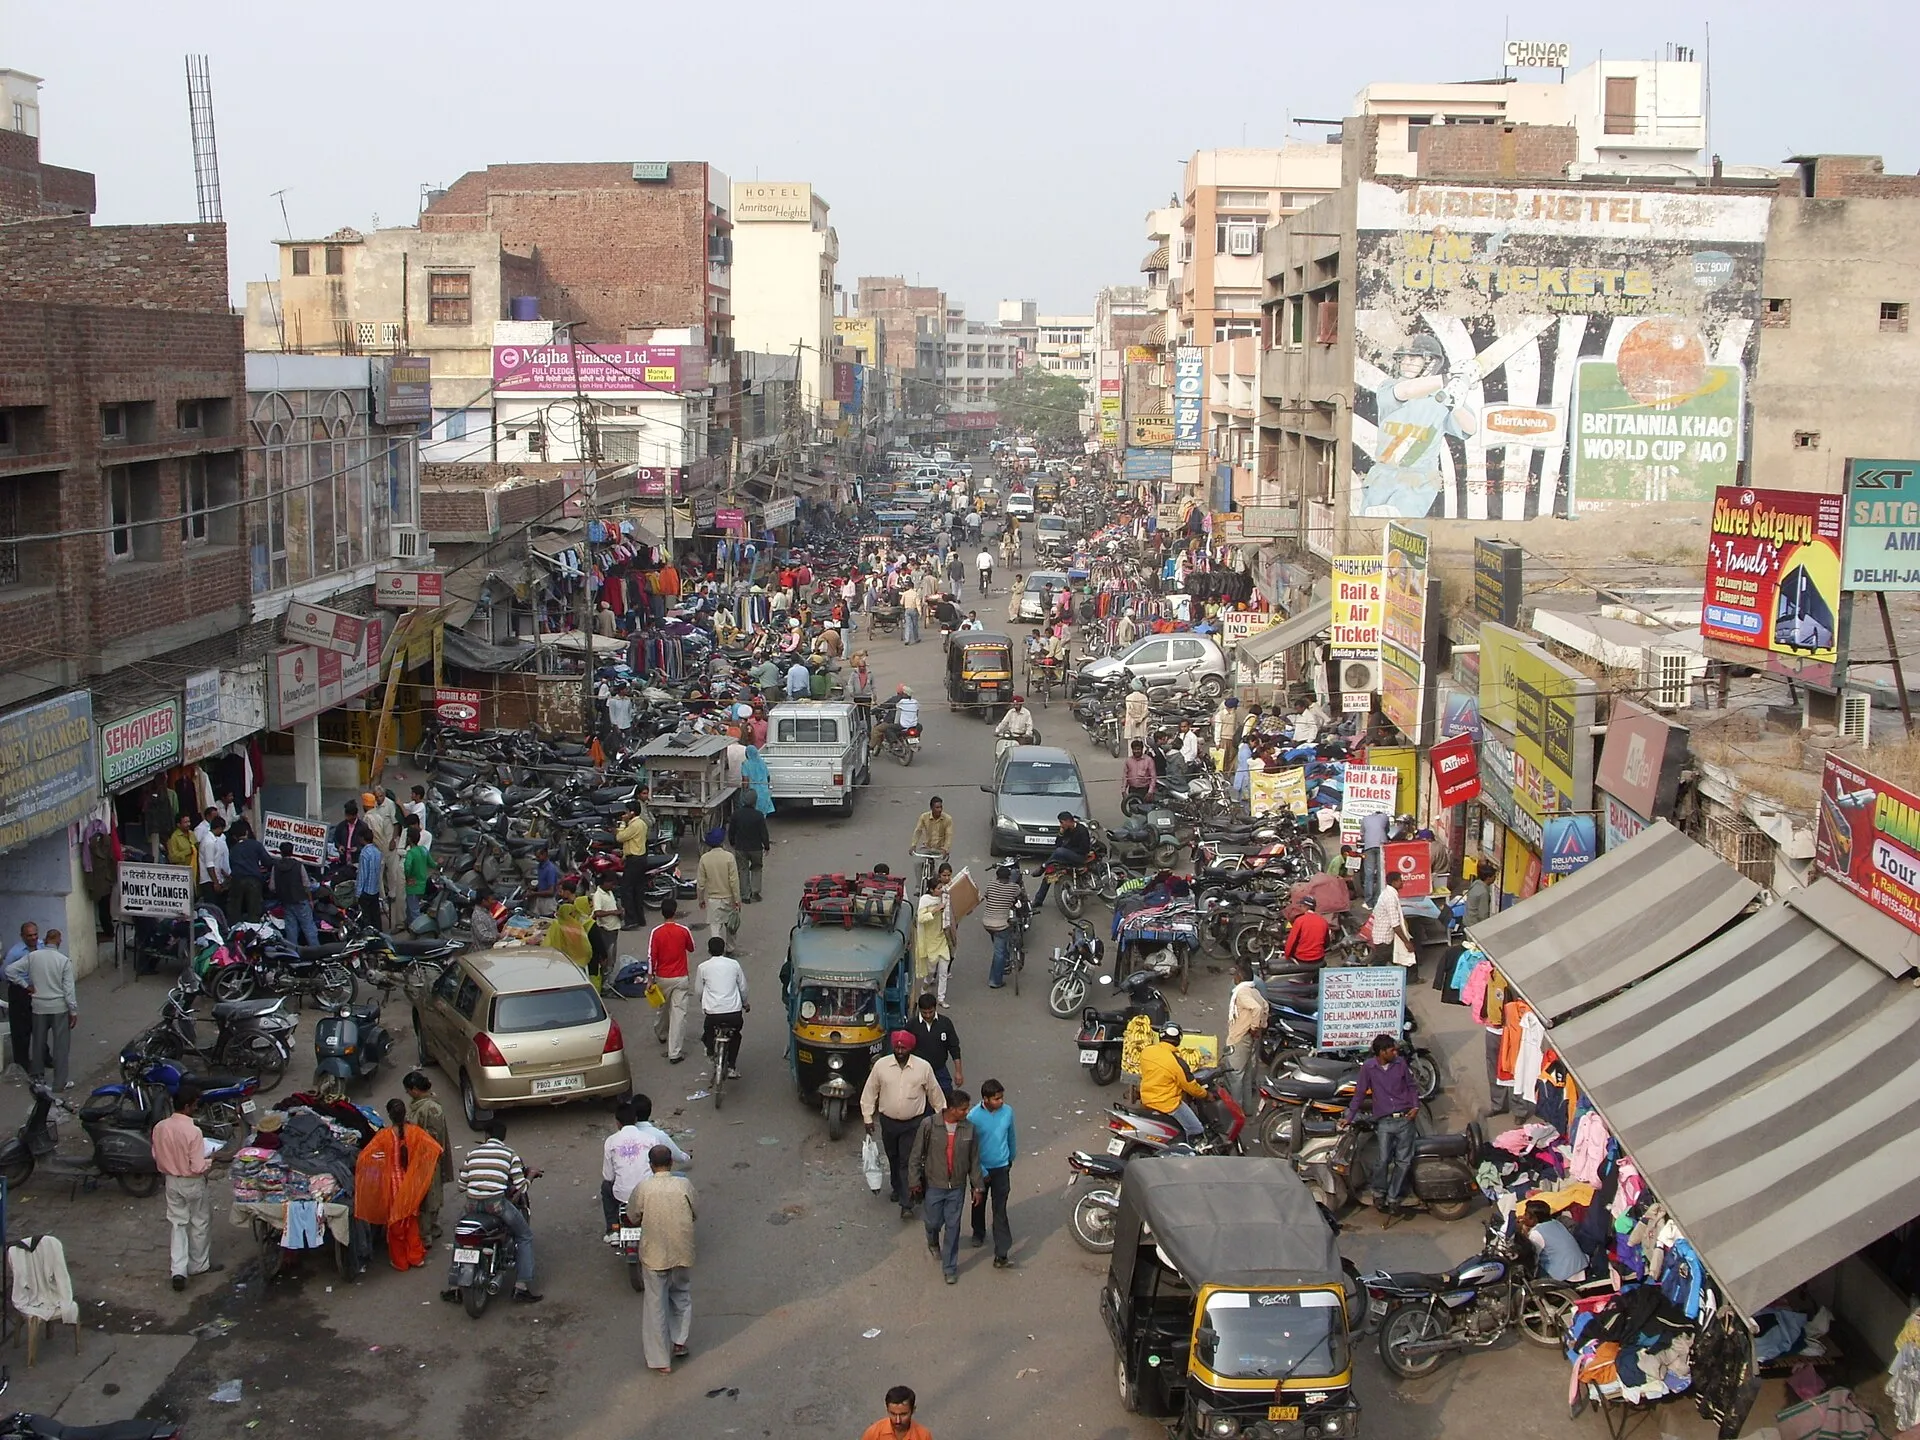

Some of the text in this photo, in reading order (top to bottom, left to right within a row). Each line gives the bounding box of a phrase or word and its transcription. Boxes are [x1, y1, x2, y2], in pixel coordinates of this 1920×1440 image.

[1507, 42, 1568, 58] CHINAR
[1516, 56, 1563, 67] HOTEL
[746, 188, 799, 197] HOTEL
[738, 202, 778, 212] Amritsar
[775, 205, 807, 219] Heights
[1533, 194, 1651, 223] HOTEL
[1687, 261, 1731, 273] ERYBODY
[522, 348, 568, 367] Majha
[575, 350, 622, 364] Finance
[624, 350, 650, 364] Ltd.
[531, 367, 548, 375] FULL
[549, 367, 579, 375] FLEDGE
[580, 367, 605, 375] MONEY
[1176, 362, 1203, 439] HOTEL
[1138, 418, 1173, 426] HOTEL
[1493, 414, 1548, 428] BRITANNIA
[1582, 413, 1733, 437] BRITANNIA KHAO
[1584, 439, 1648, 461] WORLD
[1651, 440, 1686, 461] CUP
[637, 469, 654, 480] TD.
[1713, 497, 1750, 536] Shree
[1752, 501, 1813, 549] Satguru
[1885, 532, 1920, 550] AM
[1725, 541, 1769, 577] Travels
[1333, 559, 1383, 576] SHUBH KAMN
[377, 588, 416, 597] MoneyGram
[1340, 583, 1380, 600] Rail &
[1226, 613, 1265, 624] HOTEL
[1349, 604, 1370, 621] Air
[288, 620, 331, 638] MoneyGram
[1332, 649, 1355, 659] Holiday
[1503, 663, 1517, 691] ide
[436, 691, 459, 700] SODHI
[105, 706, 174, 757] SEHAJVEER
[0, 716, 90, 775] ONEY CHANGER
[109, 740, 172, 779] ENTERPRISES
[1443, 753, 1470, 771] Airtel
[0, 766, 35, 797] OREIGN
[1345, 771, 1398, 785] Rail & Air
[1349, 786, 1391, 799] Tickets
[267, 818, 325, 838] MONEY CHANGER
[1343, 833, 1361, 842] ST
[292, 843, 314, 855] RADING
[1551, 855, 1589, 865] RELIANCE
[1551, 863, 1572, 871] Mobile
[1879, 847, 1916, 886] Tour
[1400, 872, 1425, 882] afone
[121, 881, 189, 900] MONEY CHANGER
[1880, 879, 1913, 906] Railway
[127, 897, 183, 908] FOREIGN CURRENCY
[1324, 988, 1401, 1000] SHREE SATGURU TRAVELS
